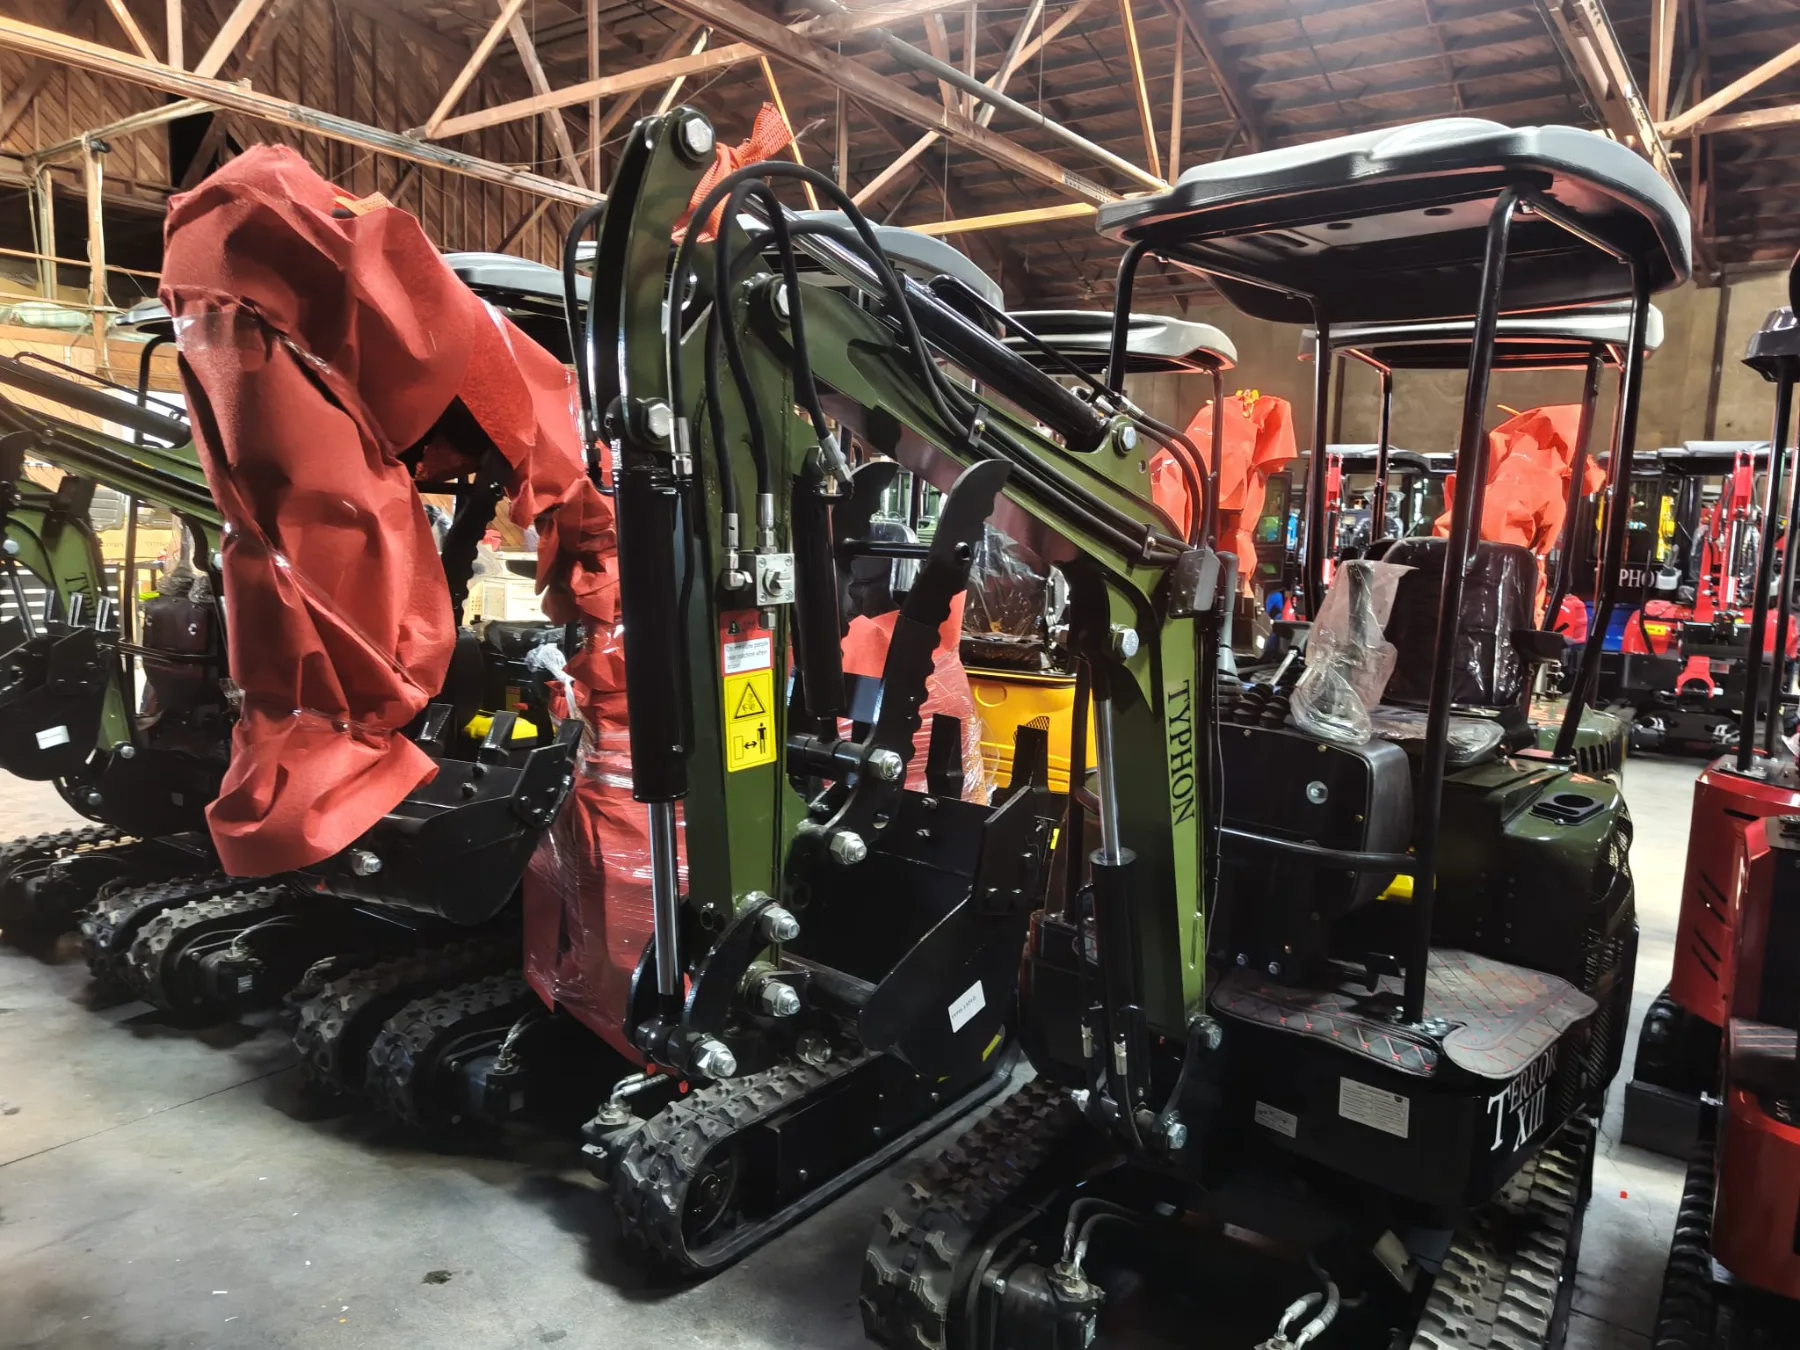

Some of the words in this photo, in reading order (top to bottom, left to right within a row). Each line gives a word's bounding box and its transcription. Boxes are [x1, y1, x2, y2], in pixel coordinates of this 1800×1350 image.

[1618, 568, 1657, 588] PHO
[1167, 679, 1195, 826] TYPHON
[1487, 1044, 1558, 1151] TERROR
[1512, 1084, 1547, 1152] XIII
